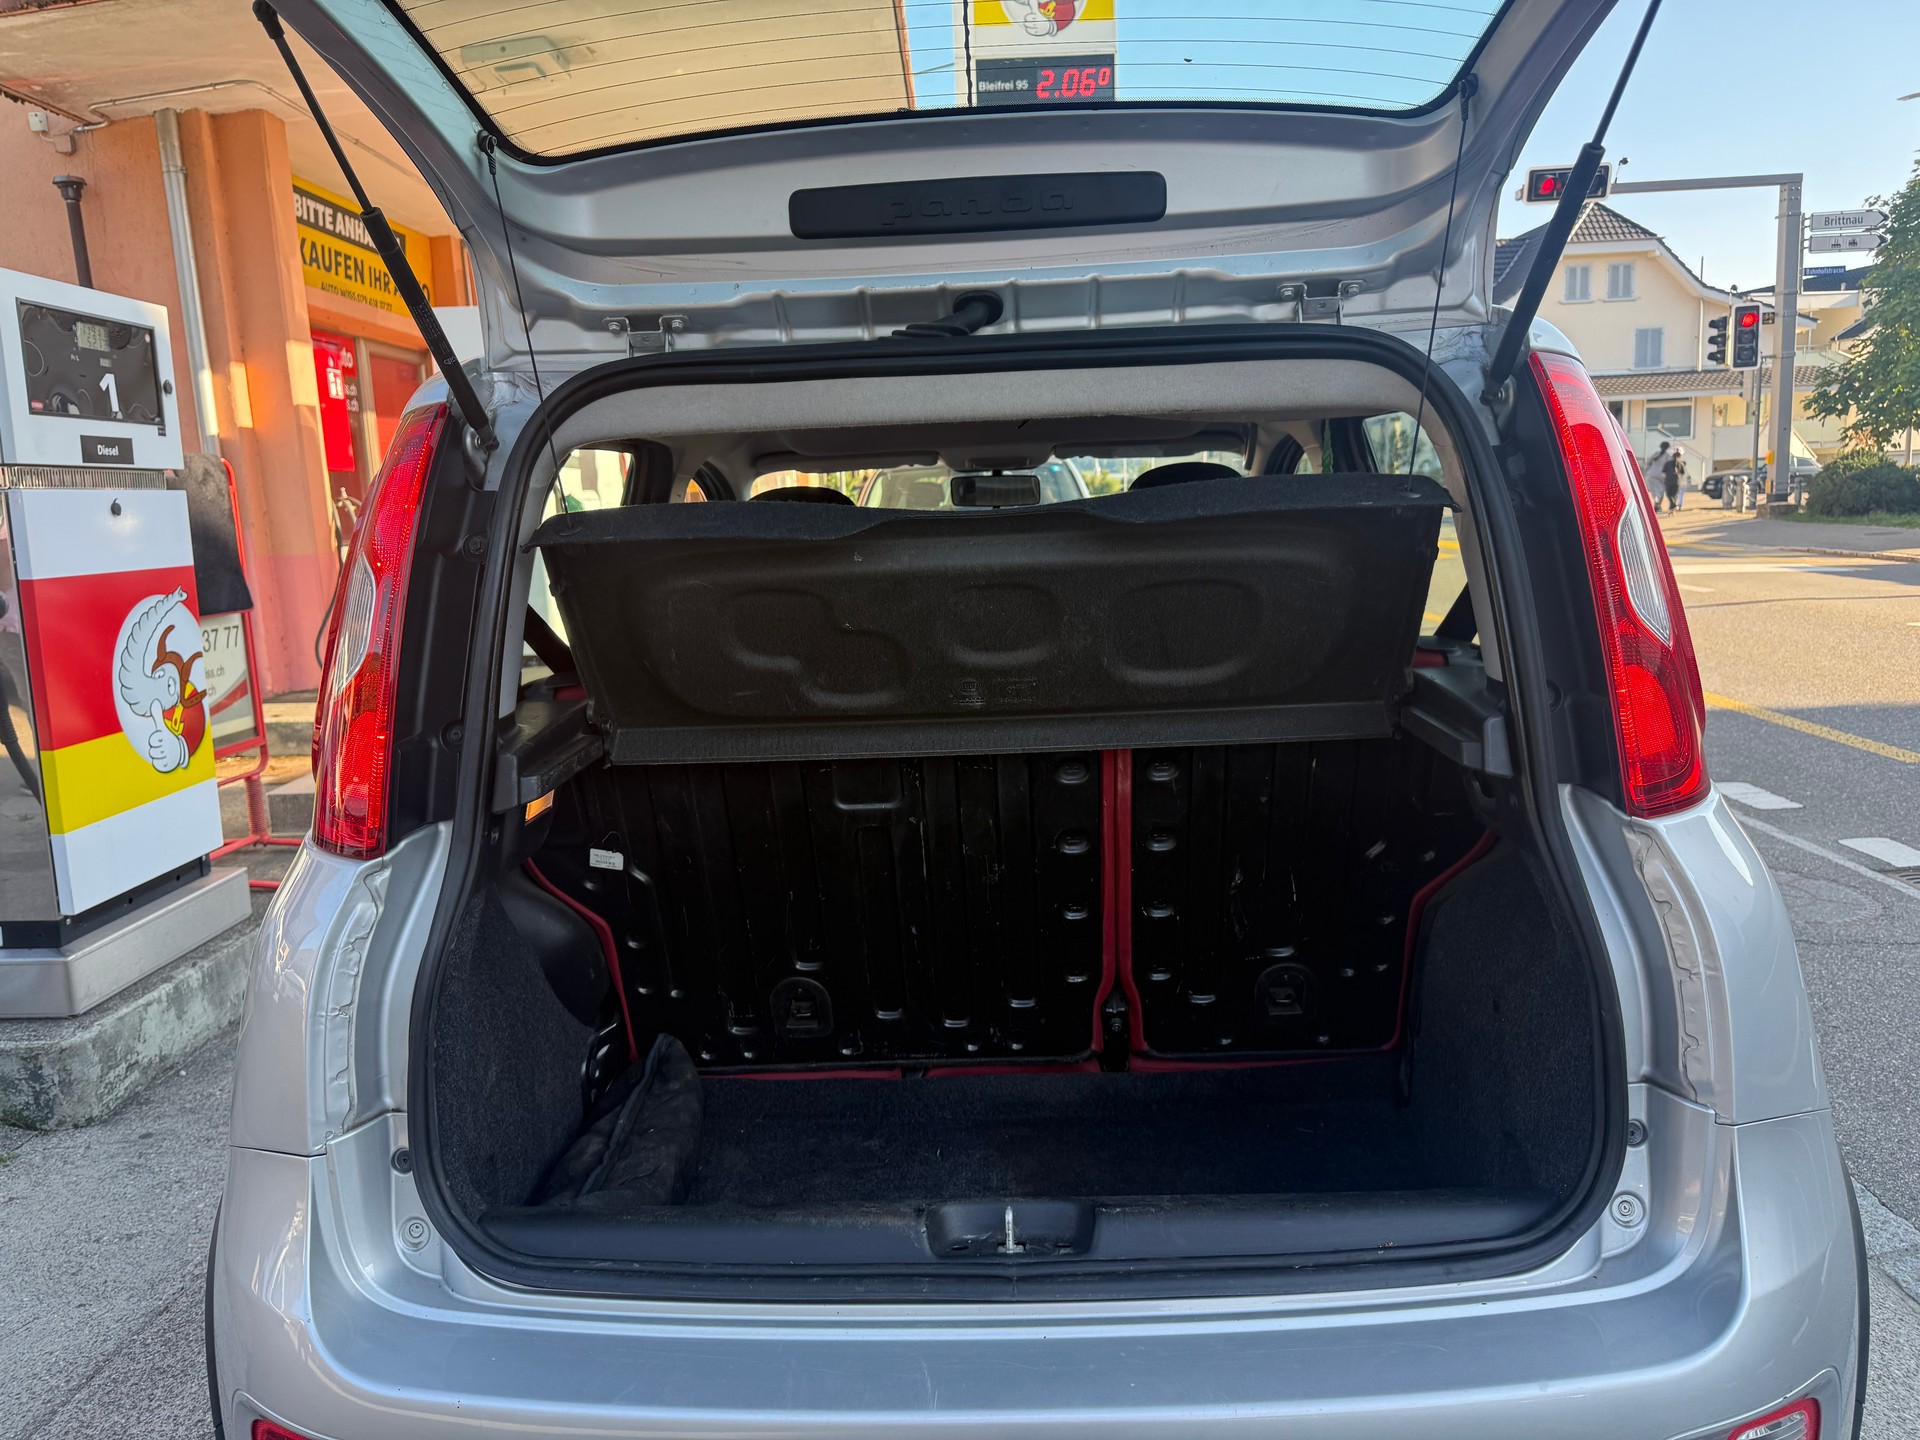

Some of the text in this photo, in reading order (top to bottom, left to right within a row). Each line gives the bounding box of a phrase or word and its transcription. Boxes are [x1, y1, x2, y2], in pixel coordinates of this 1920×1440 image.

[978, 81, 1014, 92] Bleifrei
[1015, 80, 1029, 90] 95
[293, 192, 334, 231] BITTE
[1824, 216, 1864, 226] Brittnau
[369, 266, 391, 294] IHR
[1806, 267, 1844, 275] Bahnhofstrasse
[99, 373, 120, 412] 1
[97, 444, 119, 456] Diesel
[202, 625, 240, 653] 37 77
